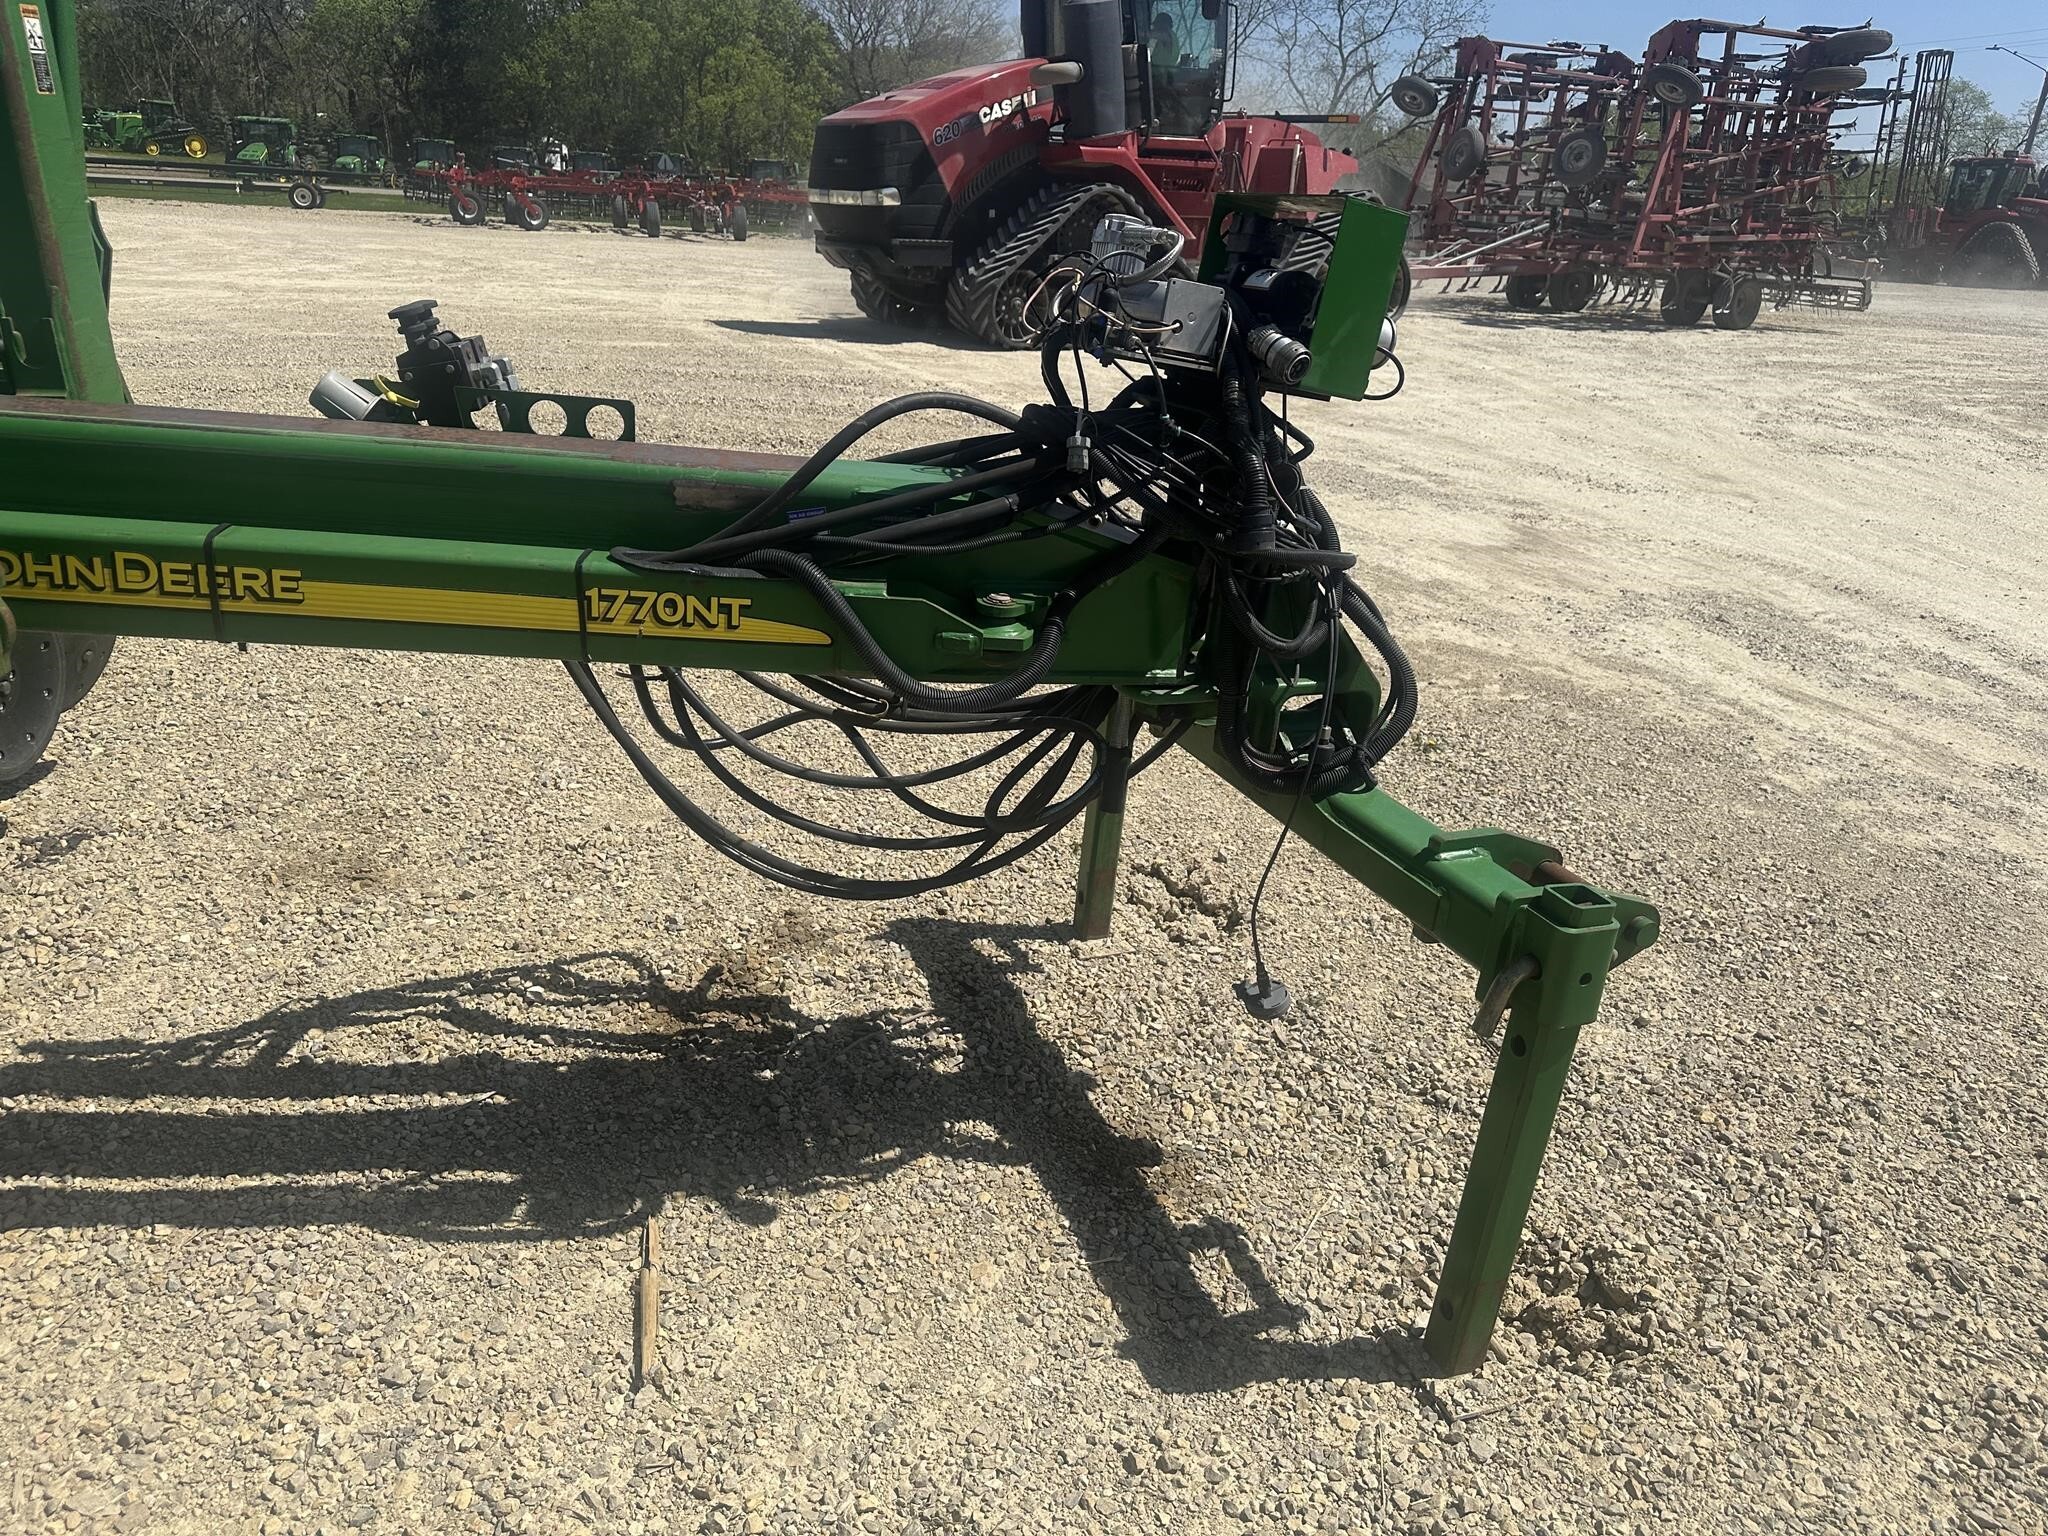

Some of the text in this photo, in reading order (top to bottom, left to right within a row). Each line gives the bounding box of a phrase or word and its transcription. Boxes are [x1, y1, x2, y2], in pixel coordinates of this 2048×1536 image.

[979, 94, 1023, 124] CASE
[933, 120, 961, 147] 620
[0, 550, 304, 605] OHN DEERE
[585, 587, 752, 631] 1770NT
